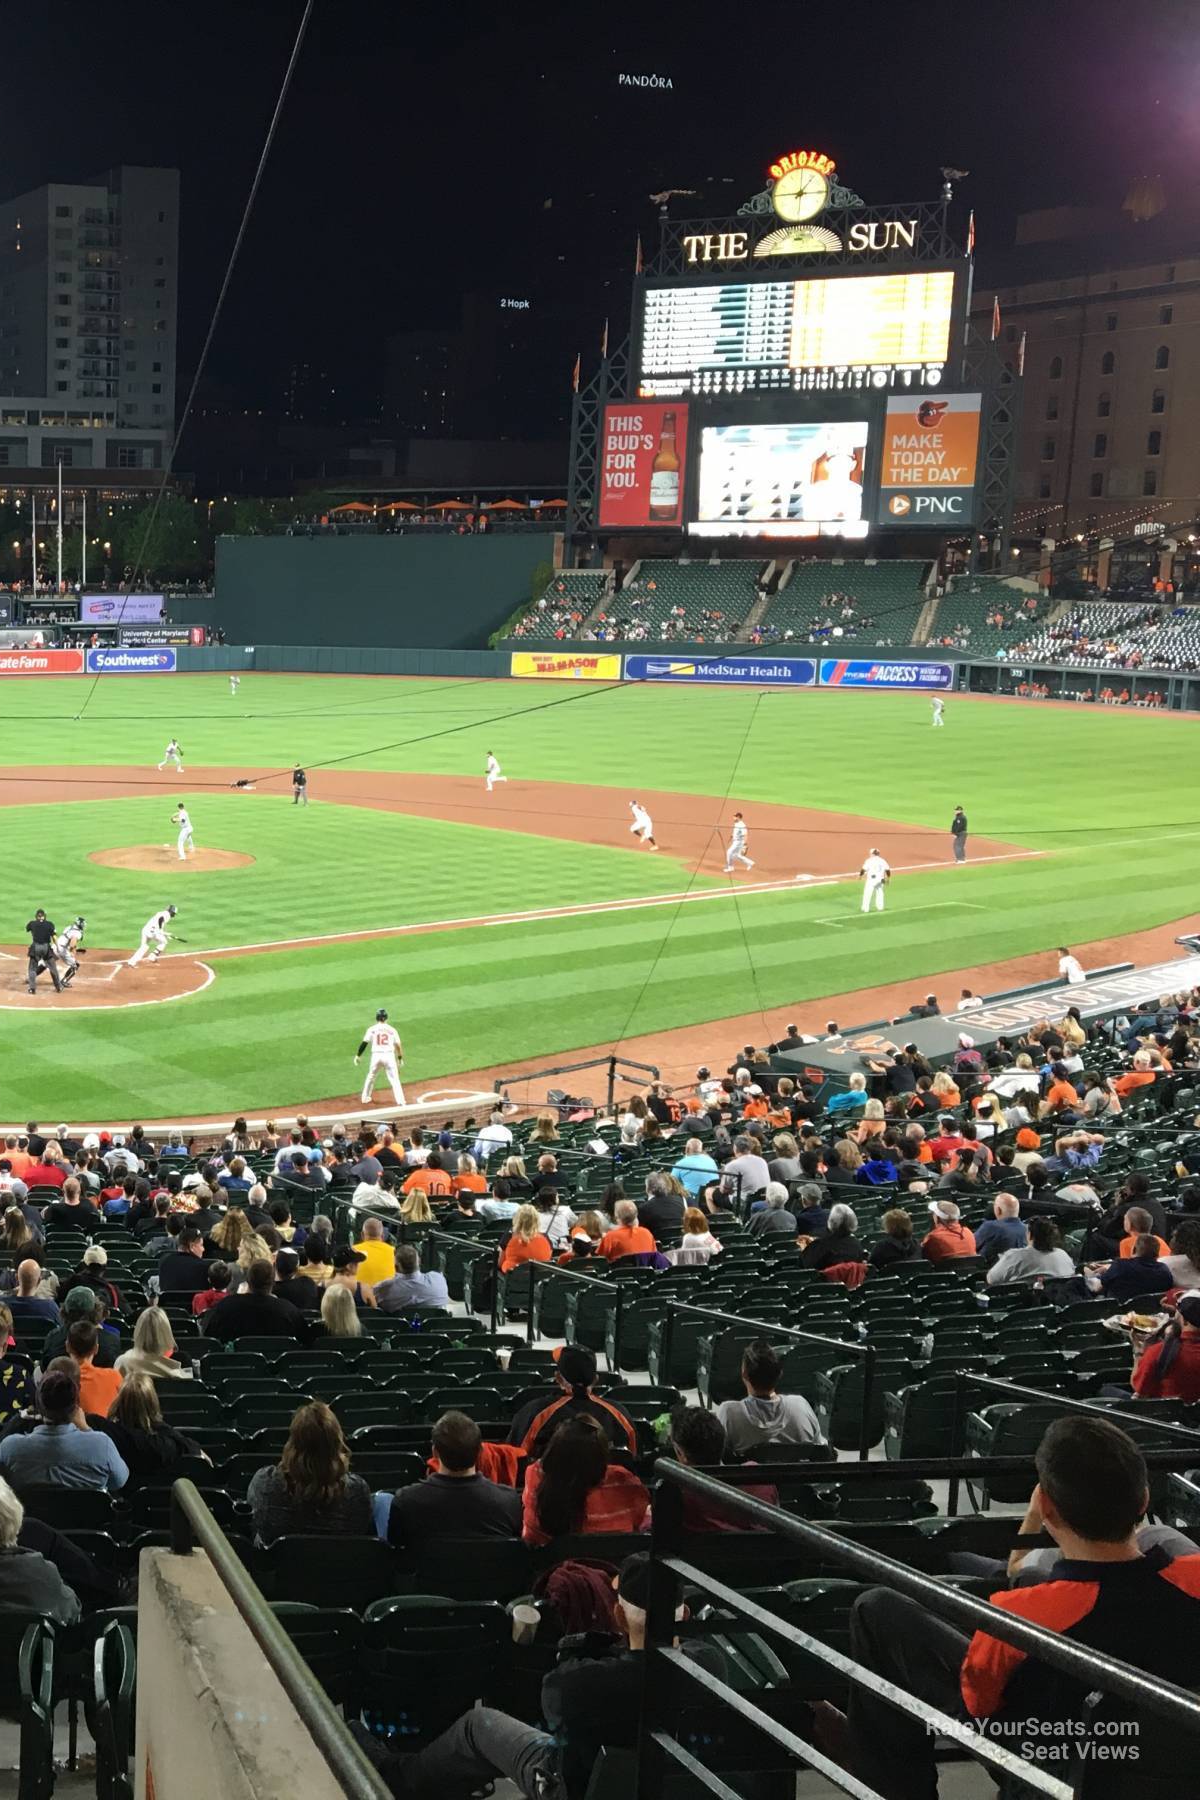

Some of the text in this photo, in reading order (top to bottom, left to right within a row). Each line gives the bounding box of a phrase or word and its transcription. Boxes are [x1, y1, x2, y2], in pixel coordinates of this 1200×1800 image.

[770, 151, 836, 178] ORIOLES
[683, 220, 919, 262] THE SUN
[500, 298, 507, 308] 2
[608, 416, 643, 432] THIS
[607, 434, 654, 451] BUD'S
[892, 433, 944, 449] MAKE
[606, 453, 636, 469] FOR
[890, 450, 947, 466] TODAY
[605, 472, 639, 488] YOU.
[890, 467, 923, 483] THE
[914, 496, 963, 513] PNC
[96, 653, 161, 666] Southwest
[697, 664, 792, 677] MedStar Health
[875, 665, 919, 682] ACCESS
[376, 1033, 389, 1046] 12
